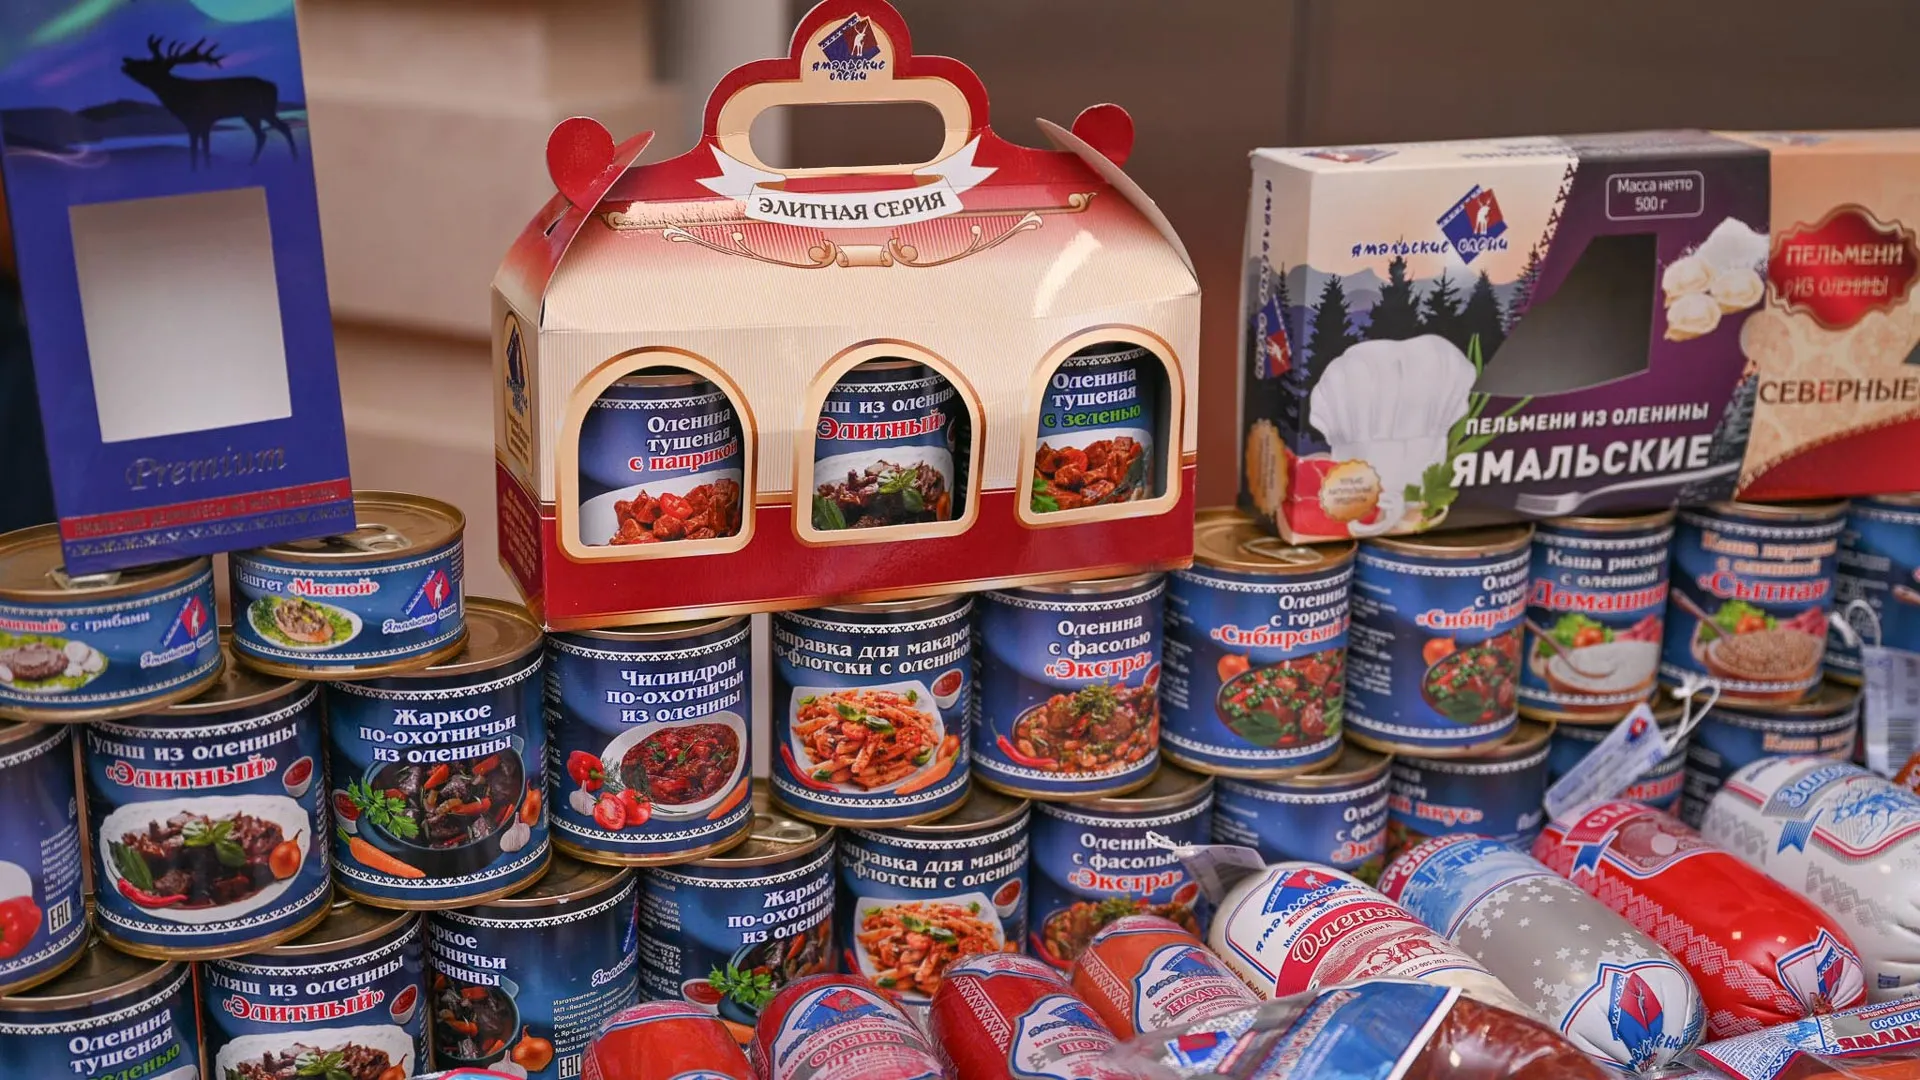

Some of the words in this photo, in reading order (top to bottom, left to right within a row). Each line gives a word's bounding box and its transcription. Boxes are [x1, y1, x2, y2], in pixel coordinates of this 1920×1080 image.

[1617, 178, 1657, 194] Масса
[1658, 178, 1693, 191] нетто
[759, 197, 867, 221] ЭЛИТНАЯ
[870, 191, 947, 219] СЕРИЯ
[1635, 196, 1659, 211] 500
[1660, 199, 1668, 211] г
[1785, 243, 1904, 266] ПЕЛЬМЕНИ
[1052, 366, 1137, 390] Оленина
[1760, 376, 1919, 404] СЕВЕРНЫЕ
[858, 401, 886, 414] из
[1051, 384, 1137, 409] тушеная
[647, 406, 731, 433] Оленина
[1042, 413, 1056, 428] с
[1063, 405, 1141, 428] зеленью
[1465, 411, 1576, 435] ПЕЛЬМЕНИ
[1581, 409, 1607, 428] ИЗ
[1612, 402, 1710, 425] ОЛЕНИНЫ
[628, 456, 643, 472] с
[648, 436, 738, 473] паприкой
[646, 425, 731, 456] тушеная
[125, 445, 288, 491] Premium
[1450, 434, 1714, 488] ЯМАЛЬСКИЕ
[1547, 549, 1603, 571] Каша
[235, 564, 284, 592] Паштет
[287, 577, 380, 598] «Мясной»
[1559, 573, 1572, 586] с
[1576, 568, 1660, 589] олениной
[1278, 585, 1348, 611] Оленина
[1474, 595, 1485, 608] с
[70, 622, 80, 631] с
[84, 611, 150, 633] грибами
[1057, 613, 1143, 637] Оленина
[1210, 616, 1342, 652] «Сибирский
[1270, 614, 1282, 627] с
[857, 645, 900, 661] для
[1047, 642, 1061, 656] с
[1066, 631, 1151, 661] фасолью
[620, 656, 737, 687] Чилиндрон
[879, 662, 892, 676] с
[1043, 650, 1153, 681] «Экстра»
[606, 670, 745, 705] по-охотничьи
[392, 704, 492, 730] Жаркое
[621, 708, 649, 723] из
[655, 689, 741, 723] оленины
[86, 730, 145, 760] Гуляш
[153, 746, 186, 762] из
[192, 722, 299, 760] оленины
[359, 714, 517, 746] по-охотничьи
[373, 746, 401, 763] из
[407, 735, 513, 764] оленины
[105, 752, 278, 790] «Элитный»
[1335, 829, 1346, 842] с
[841, 839, 918, 872] аправка
[923, 859, 964, 875] для
[841, 854, 938, 889] о-флотски
[943, 876, 956, 889] с
[1072, 853, 1084, 866] с
[762, 872, 830, 909] Жаркое
[1067, 867, 1184, 895] «Экстра»
[428, 921, 478, 949] аркое
[742, 931, 768, 944] из
[1283, 916, 1312, 949] Мясная
[1312, 899, 1350, 919] колбаса
[1292, 906, 1415, 964] Оленья
[430, 939, 507, 970] отничьи
[204, 962, 261, 997] Гуляш
[268, 983, 298, 997] из
[305, 955, 404, 995] оленины
[222, 986, 386, 1023] «Элитный»
[68, 1008, 172, 1055] Оленина
[1870, 1009, 1920, 1031] сосиск
[68, 1026, 173, 1076] тушеная
[555, 1044, 576, 1054] Масса
